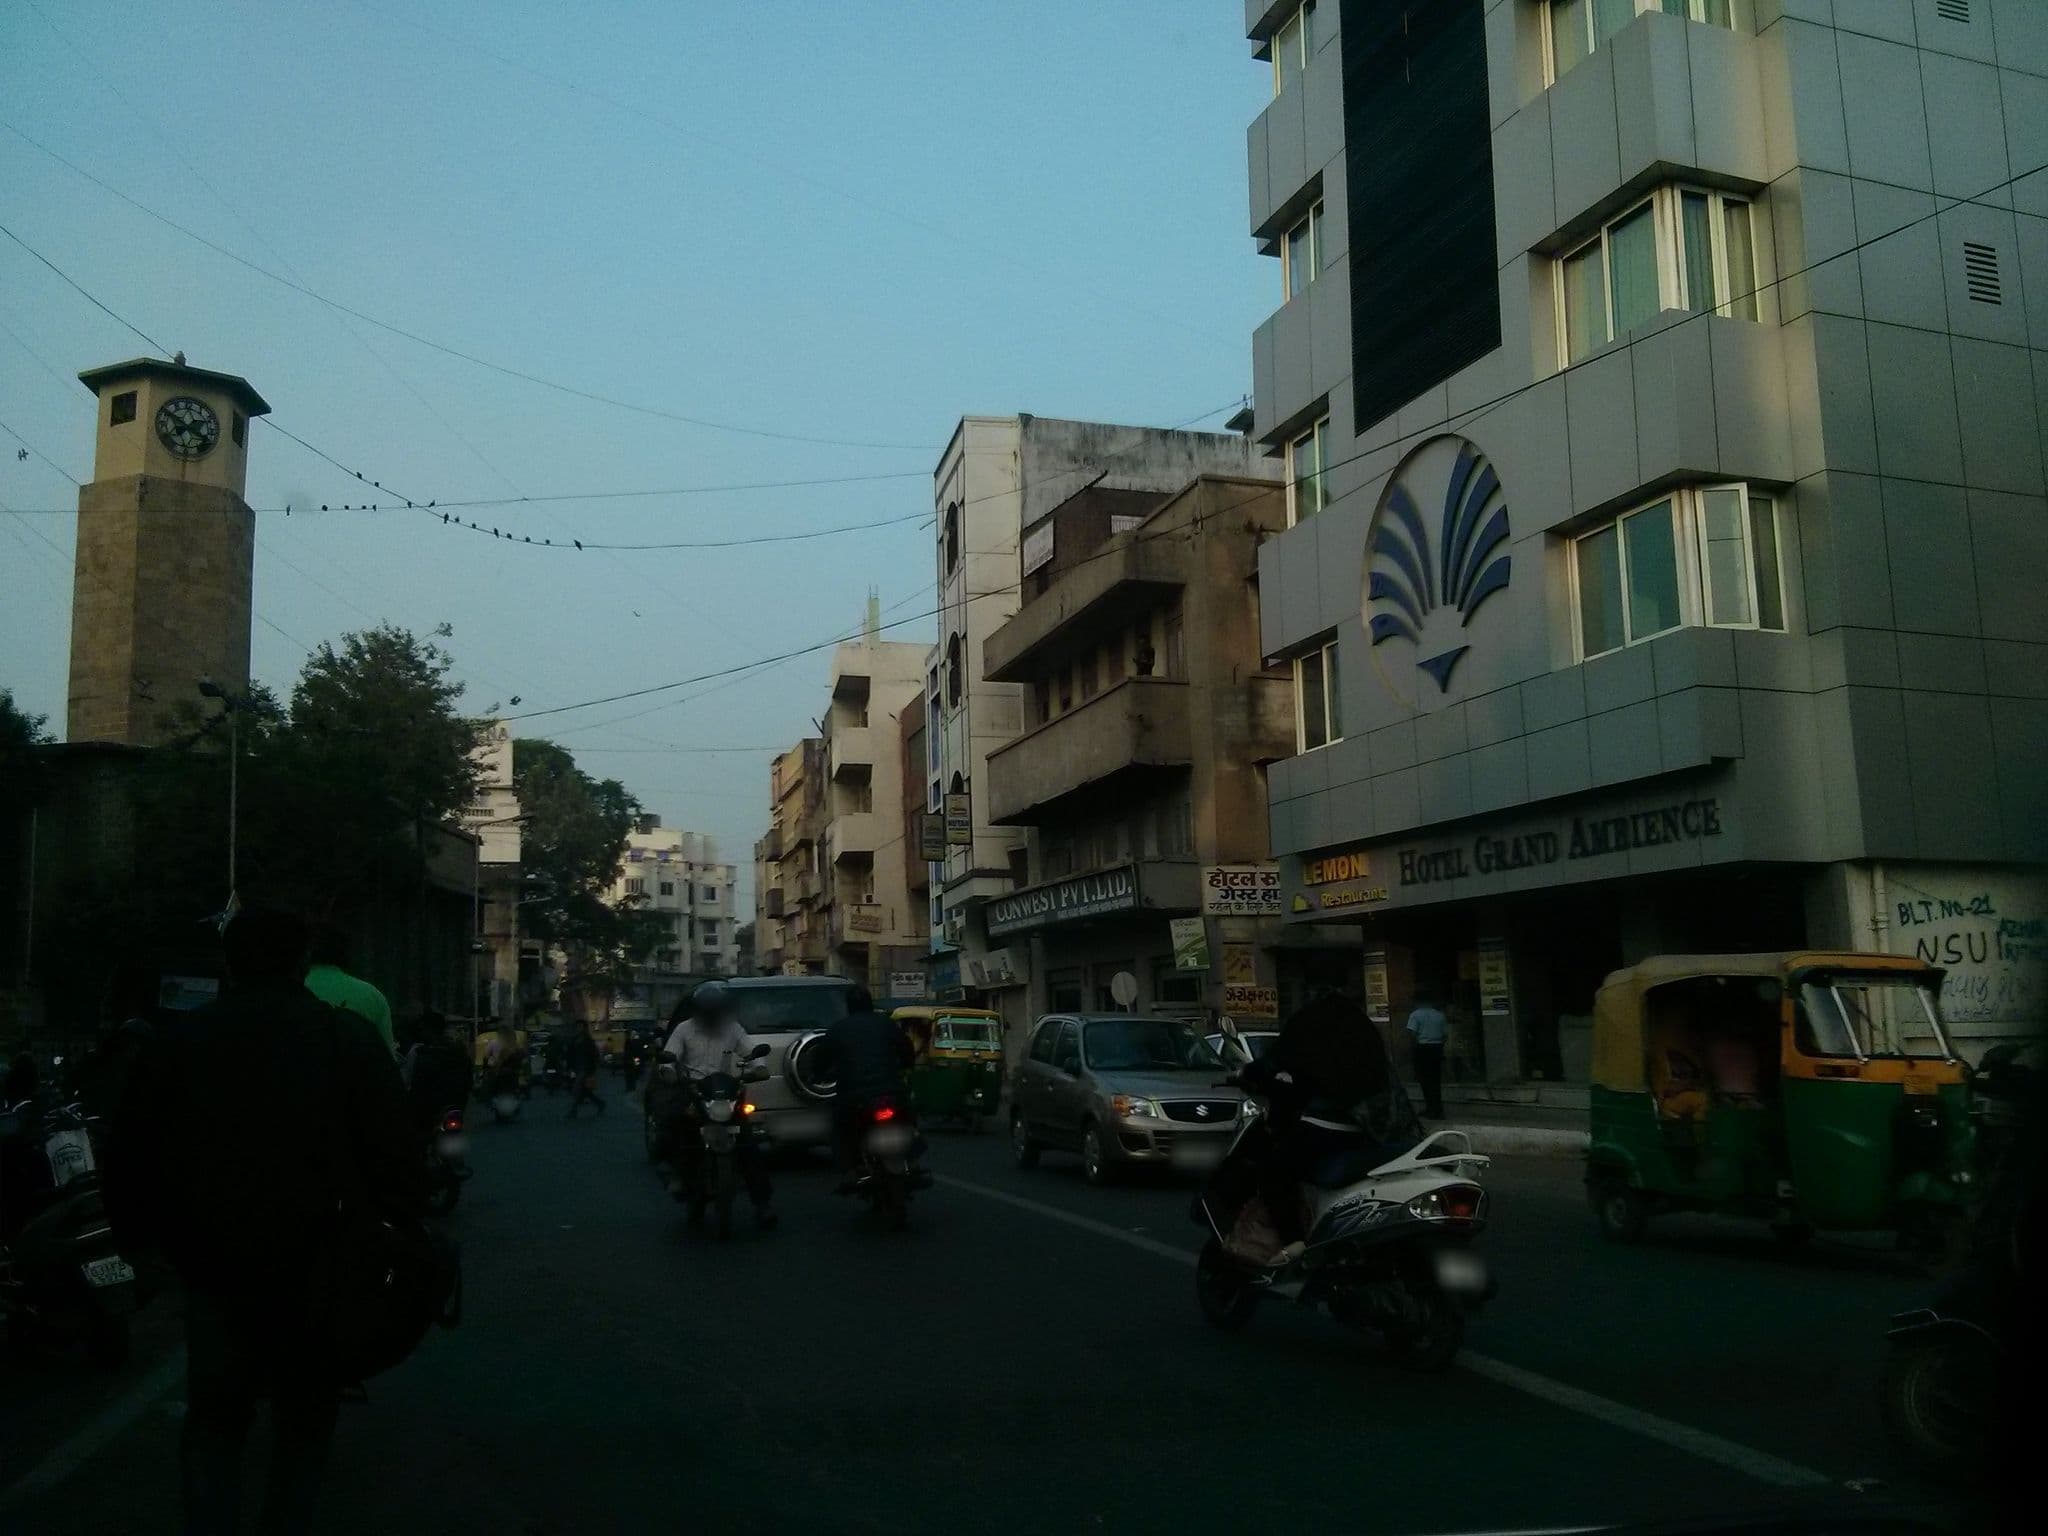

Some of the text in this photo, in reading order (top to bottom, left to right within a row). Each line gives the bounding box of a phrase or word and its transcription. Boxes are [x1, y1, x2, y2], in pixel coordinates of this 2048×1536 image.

[1474, 831, 1559, 875] GRAND
[1567, 797, 1723, 860] AMBIENCE
[1206, 867, 1257, 888] होटल
[1303, 852, 1369, 887] LEMON
[994, 888, 1057, 923] CONWEST
[1260, 888, 1281, 903] हा
